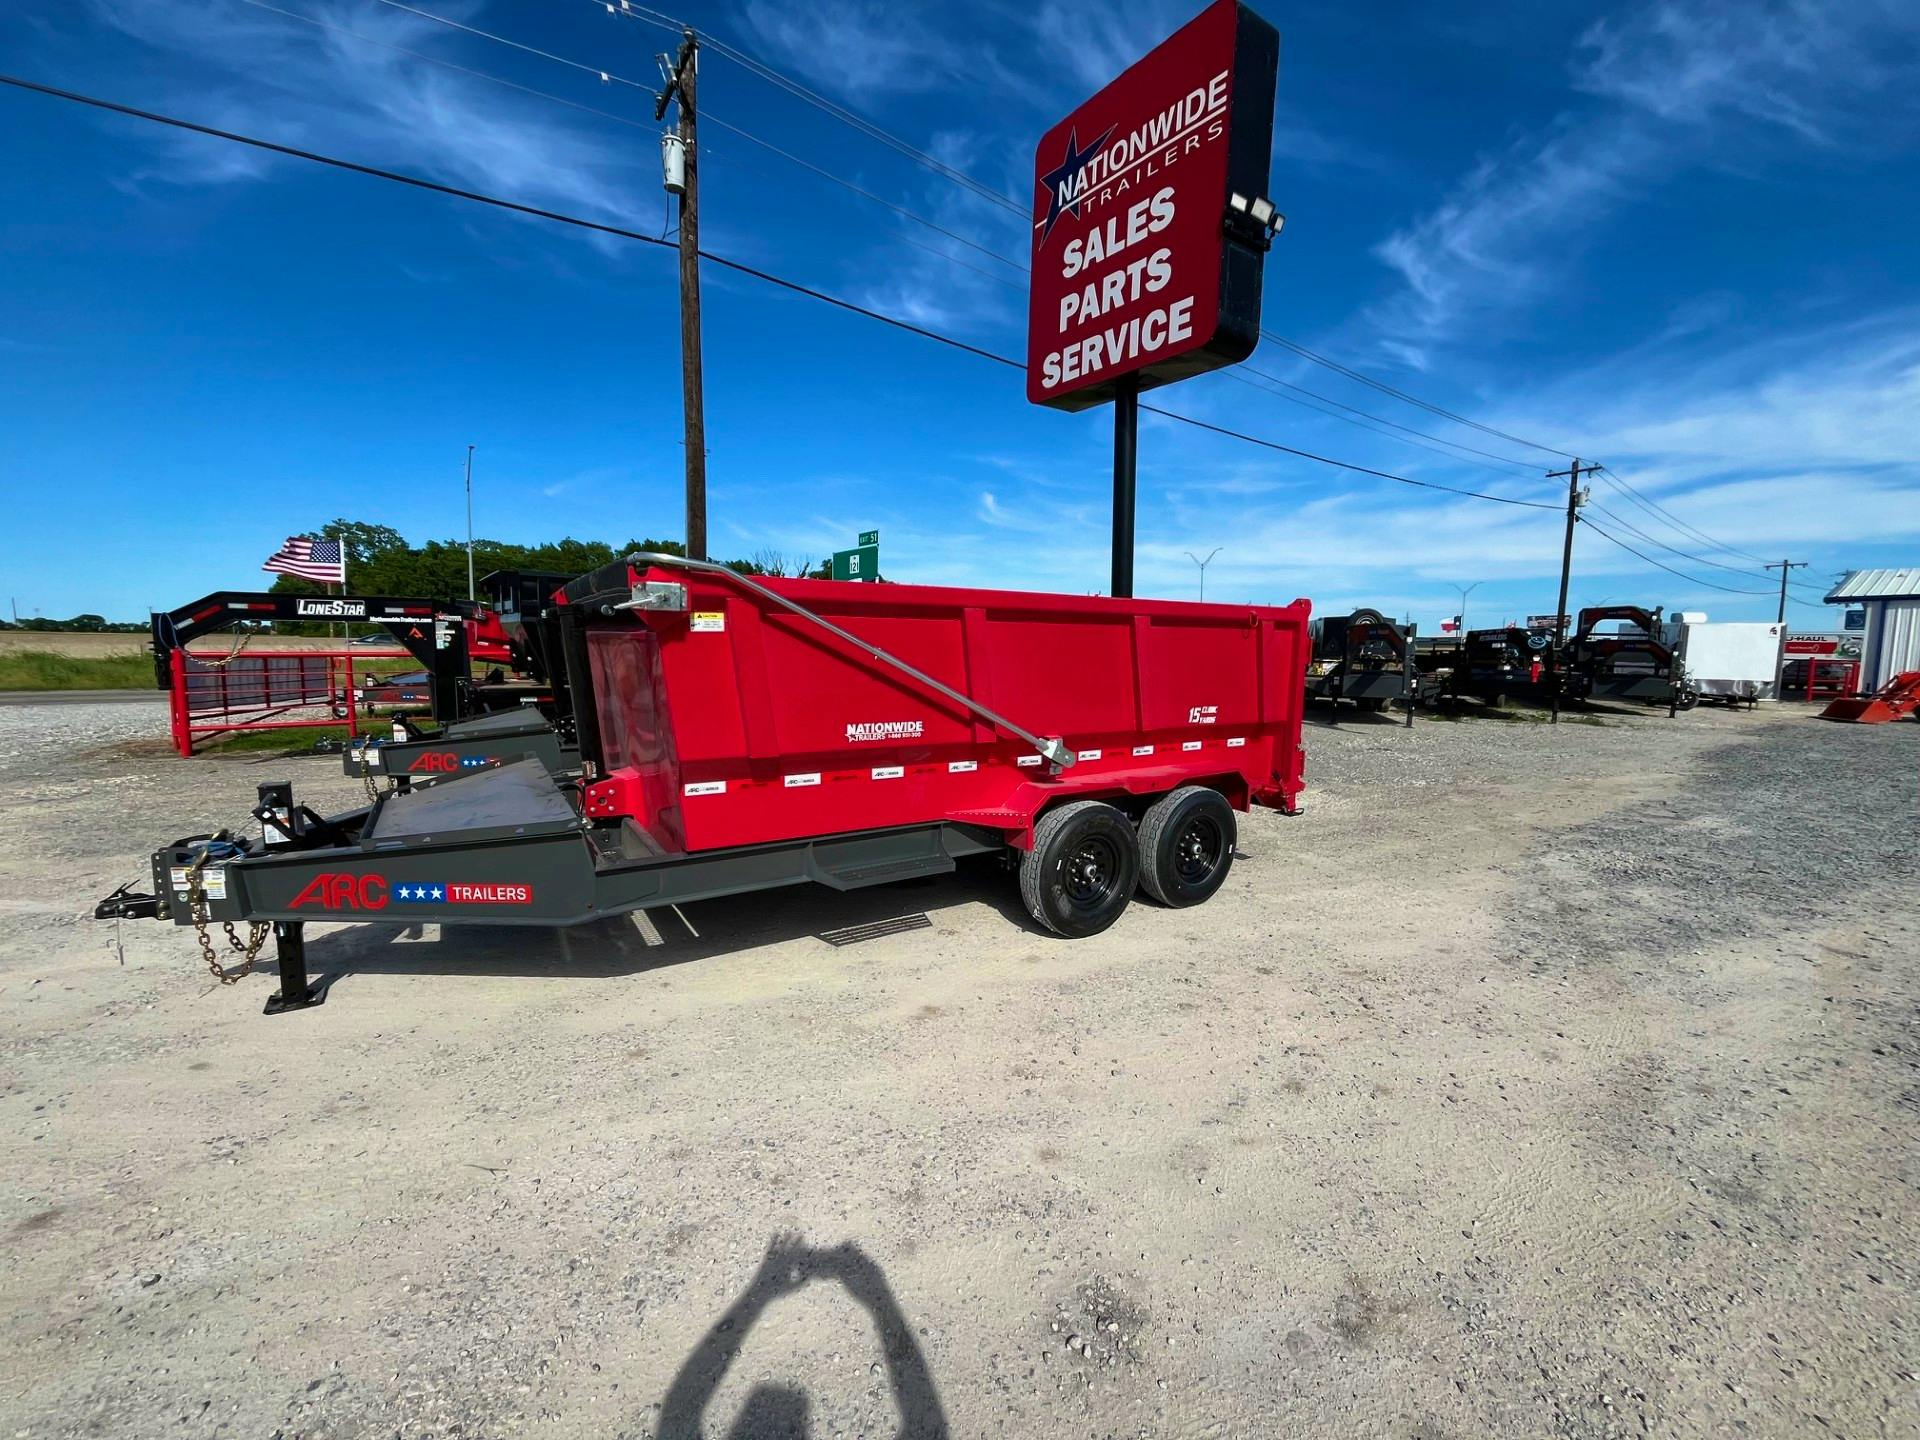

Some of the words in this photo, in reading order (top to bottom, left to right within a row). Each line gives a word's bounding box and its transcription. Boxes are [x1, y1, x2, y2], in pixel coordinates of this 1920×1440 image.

[1057, 69, 1229, 208] NATIONWIDE
[1084, 119, 1223, 213] TRAILERS
[1062, 186, 1175, 279] SALES
[1059, 247, 1172, 333] PARTS
[1041, 295, 1194, 389] SERVICE
[870, 532, 877, 543] 51
[850, 561, 859, 572] 121
[846, 720, 923, 735] NATIONWIDE
[1189, 706, 1202, 723] 15
[854, 733, 886, 742] TRAILERS
[407, 751, 459, 772] ARC
[287, 873, 389, 911] ARC
[452, 885, 527, 902] TRAILERS
